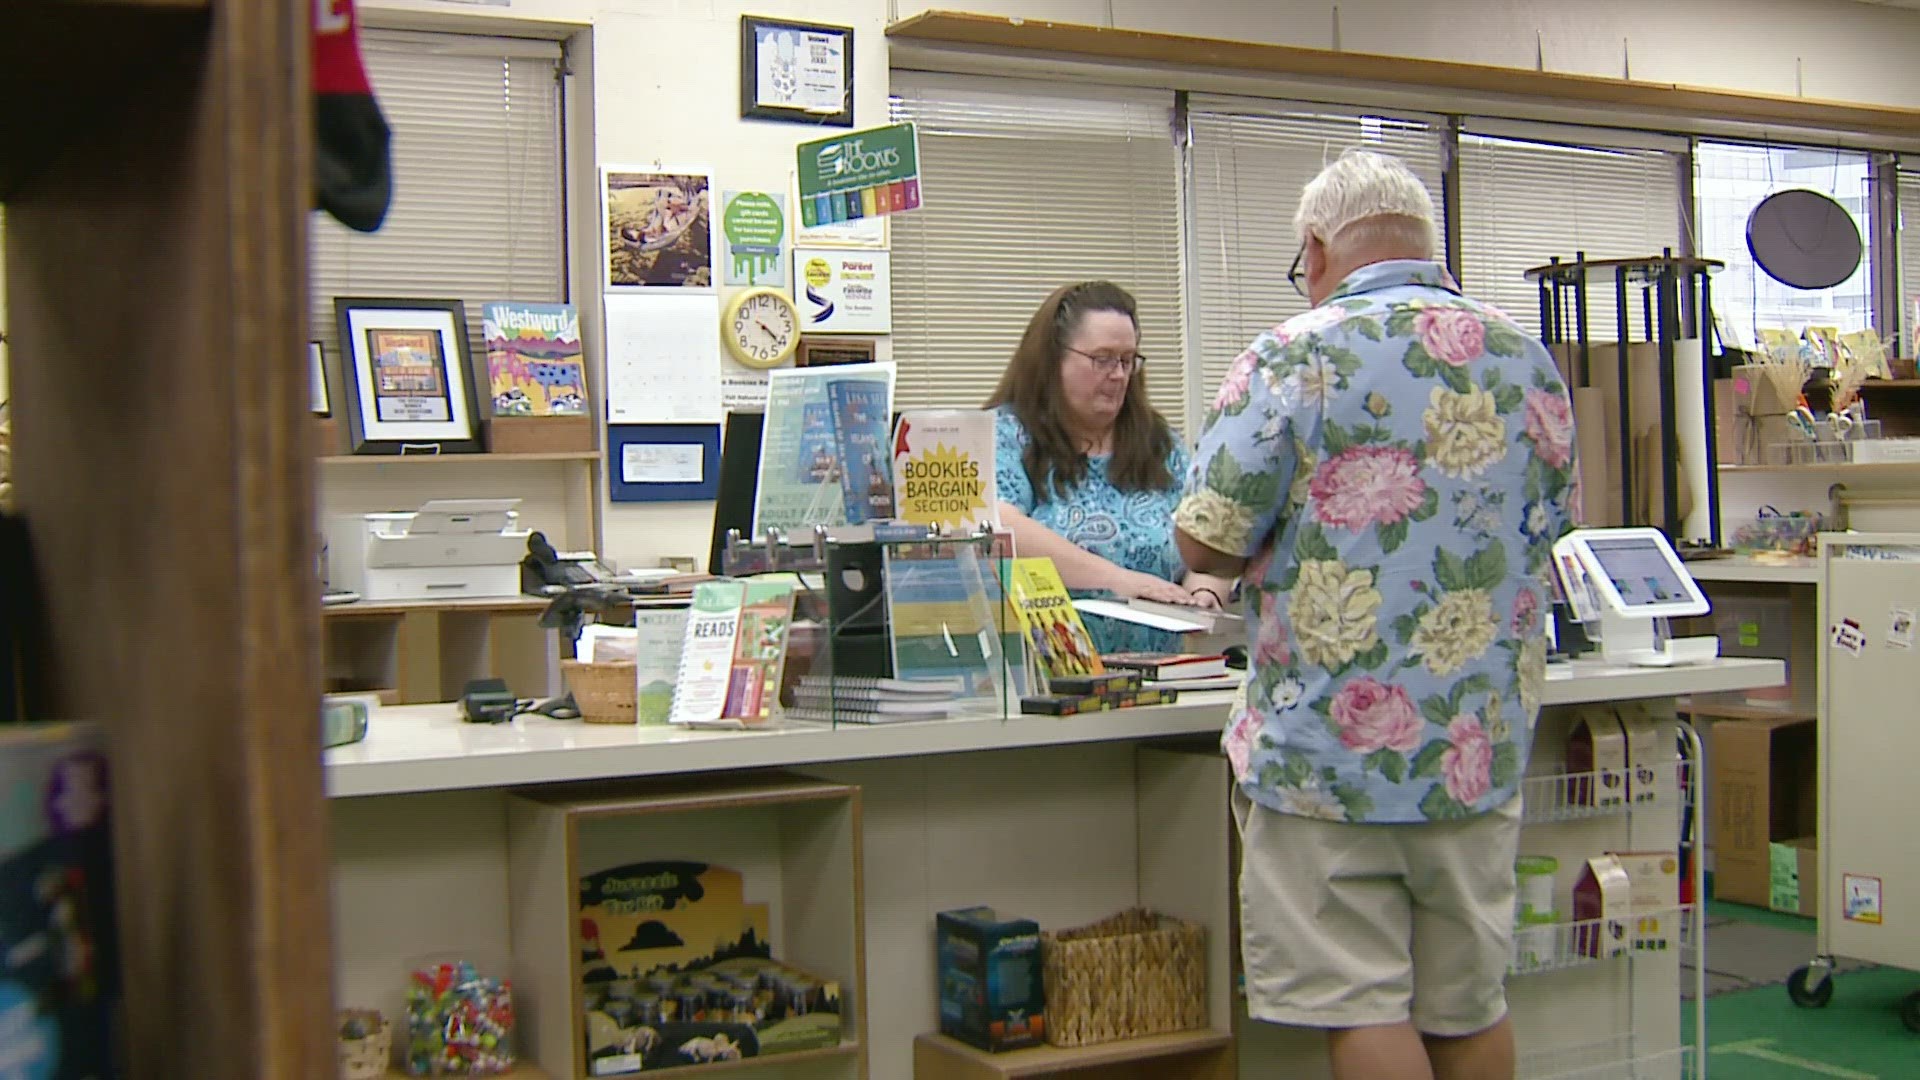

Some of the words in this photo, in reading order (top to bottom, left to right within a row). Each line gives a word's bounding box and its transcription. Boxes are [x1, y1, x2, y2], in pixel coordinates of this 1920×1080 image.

[844, 139, 864, 154] THE
[736, 199, 755, 207] Please
[740, 209, 751, 217] gift
[842, 262, 872, 270] Parent
[749, 298, 756, 310] 11
[758, 295, 769, 307] 12
[739, 308, 749, 320] 10
[780, 306, 787, 317] 2
[492, 306, 569, 332] Westword
[735, 321, 743, 333] 9
[784, 321, 791, 333] 3
[740, 336, 748, 348] 8
[750, 346, 758, 357] 7
[760, 349, 768, 360] 6
[771, 345, 778, 357] 5
[905, 462, 979, 478] BOOKIES
[907, 480, 978, 498] BARGAIN
[914, 499, 969, 512] SECTION
[1019, 595, 1068, 609] HANDBOOK
[695, 621, 736, 638] READS
